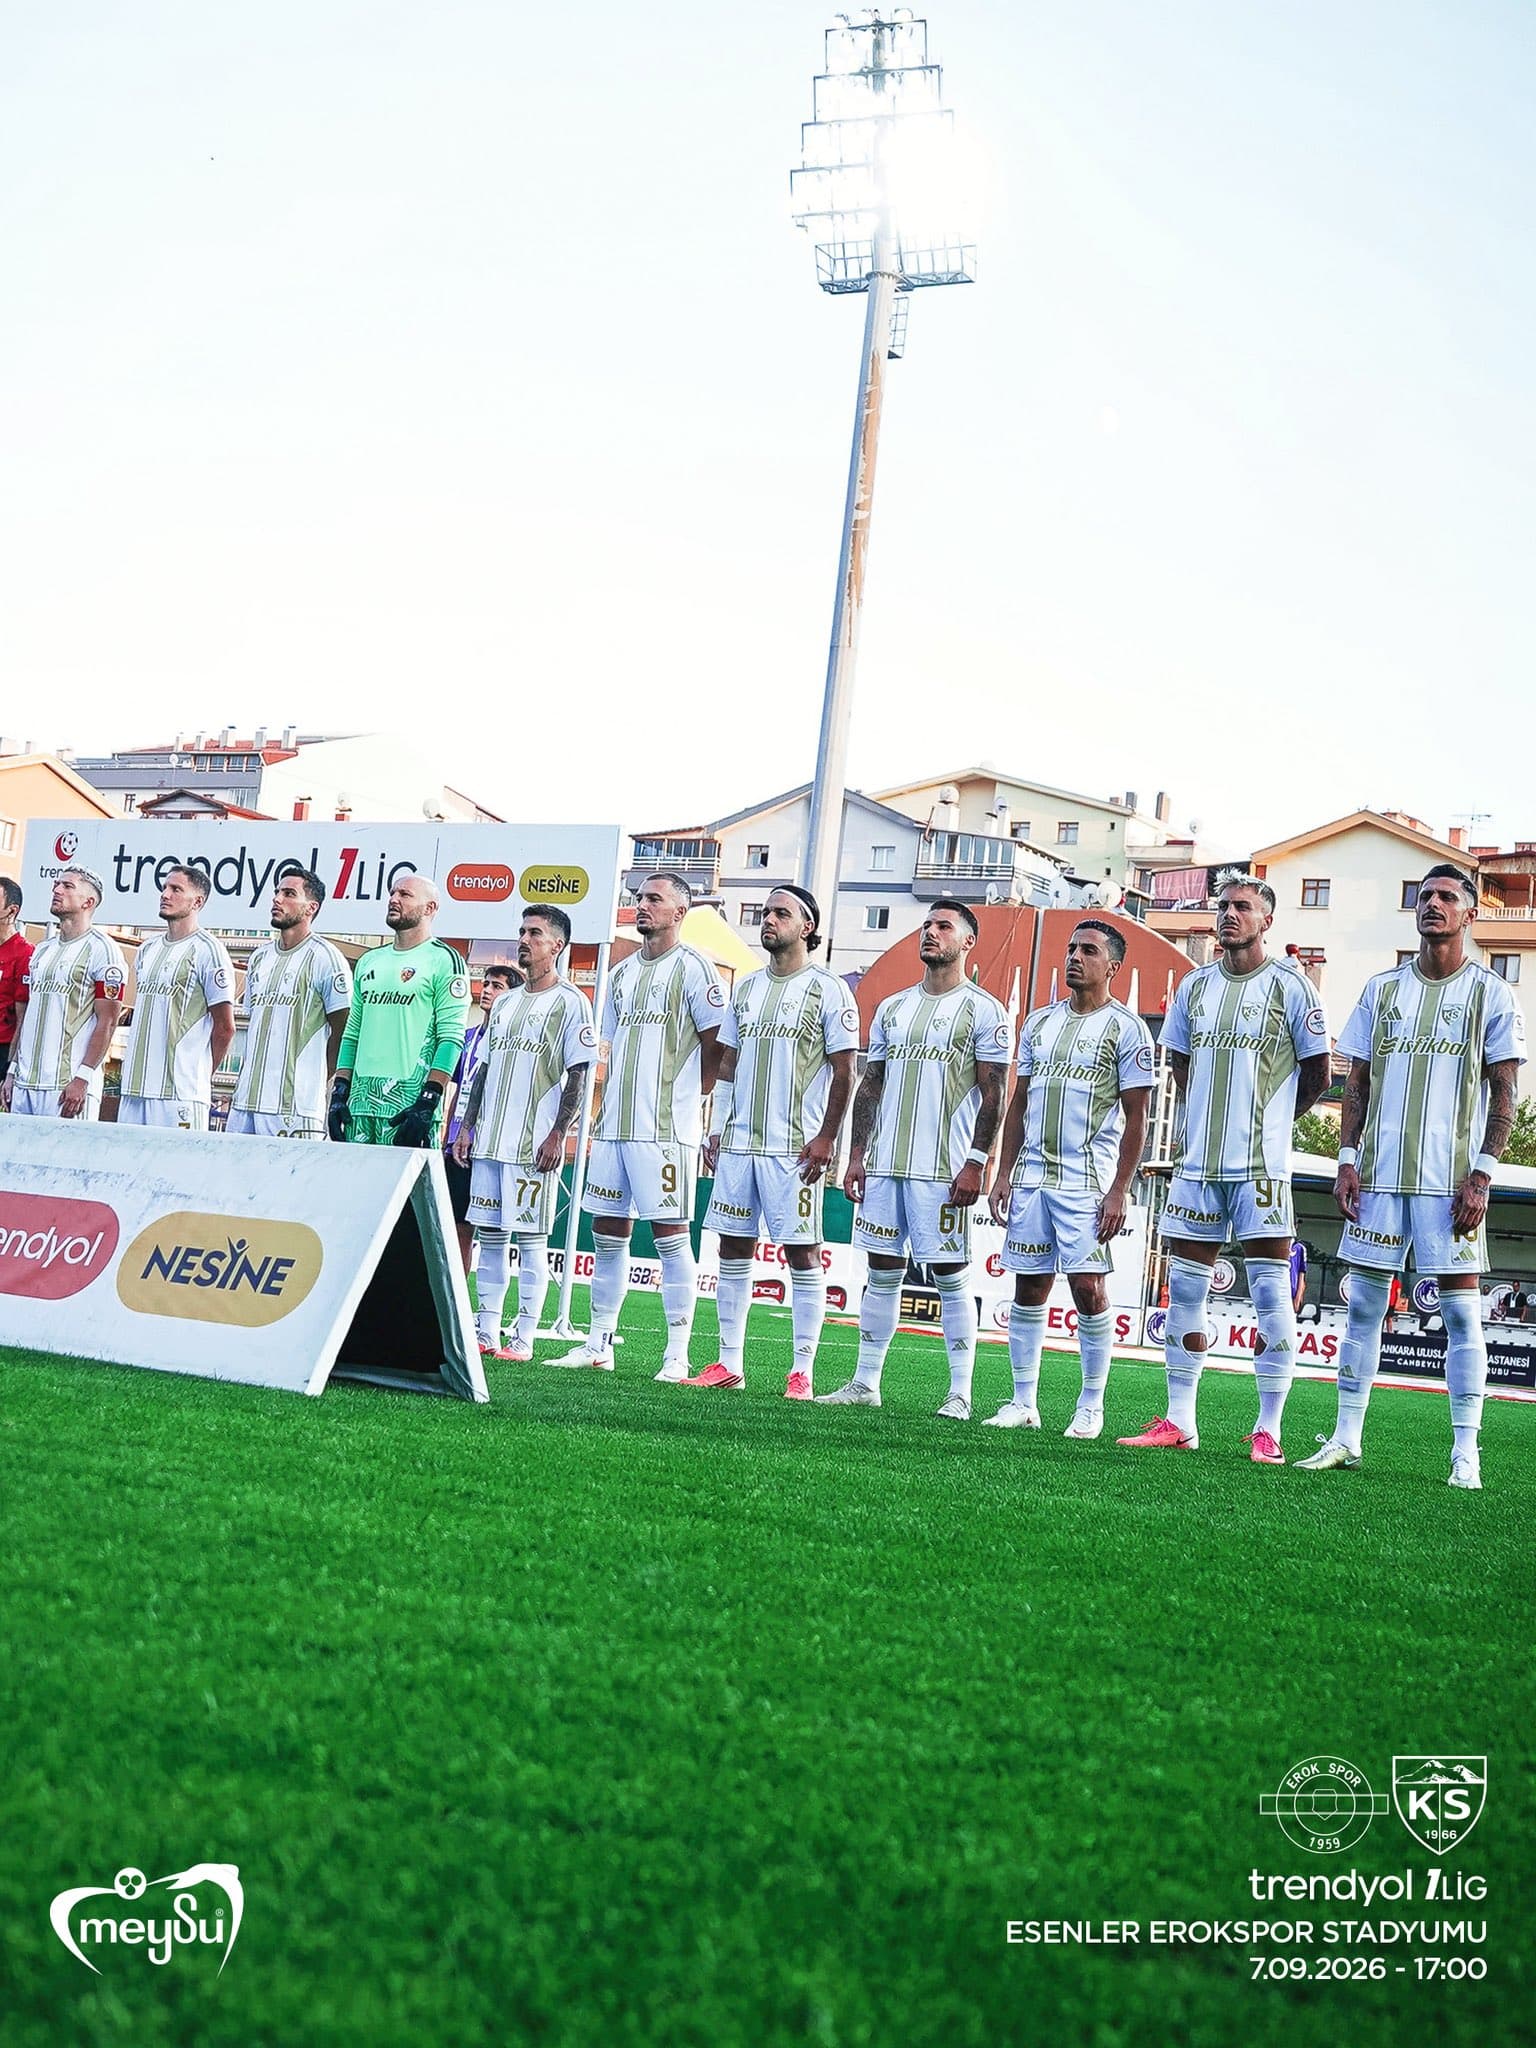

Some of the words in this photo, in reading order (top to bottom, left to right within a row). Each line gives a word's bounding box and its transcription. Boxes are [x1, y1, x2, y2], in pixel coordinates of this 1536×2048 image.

[39, 865, 64, 878] tren
[452, 873, 509, 891] trendyol
[661, 1163, 677, 1193] 9
[516, 1178, 542, 1208] 77
[1167, 1203, 1222, 1222] OYTRANS
[855, 1217, 900, 1238] OYTRANS
[0, 1226, 105, 1268] endyol
[1228, 1324, 1339, 1364] KEAŞ
[1380, 1343, 1415, 1357] ANKARA
[1487, 1355, 1530, 1368] ASTANESİ
[1487, 1367, 1509, 1376] RUBU
